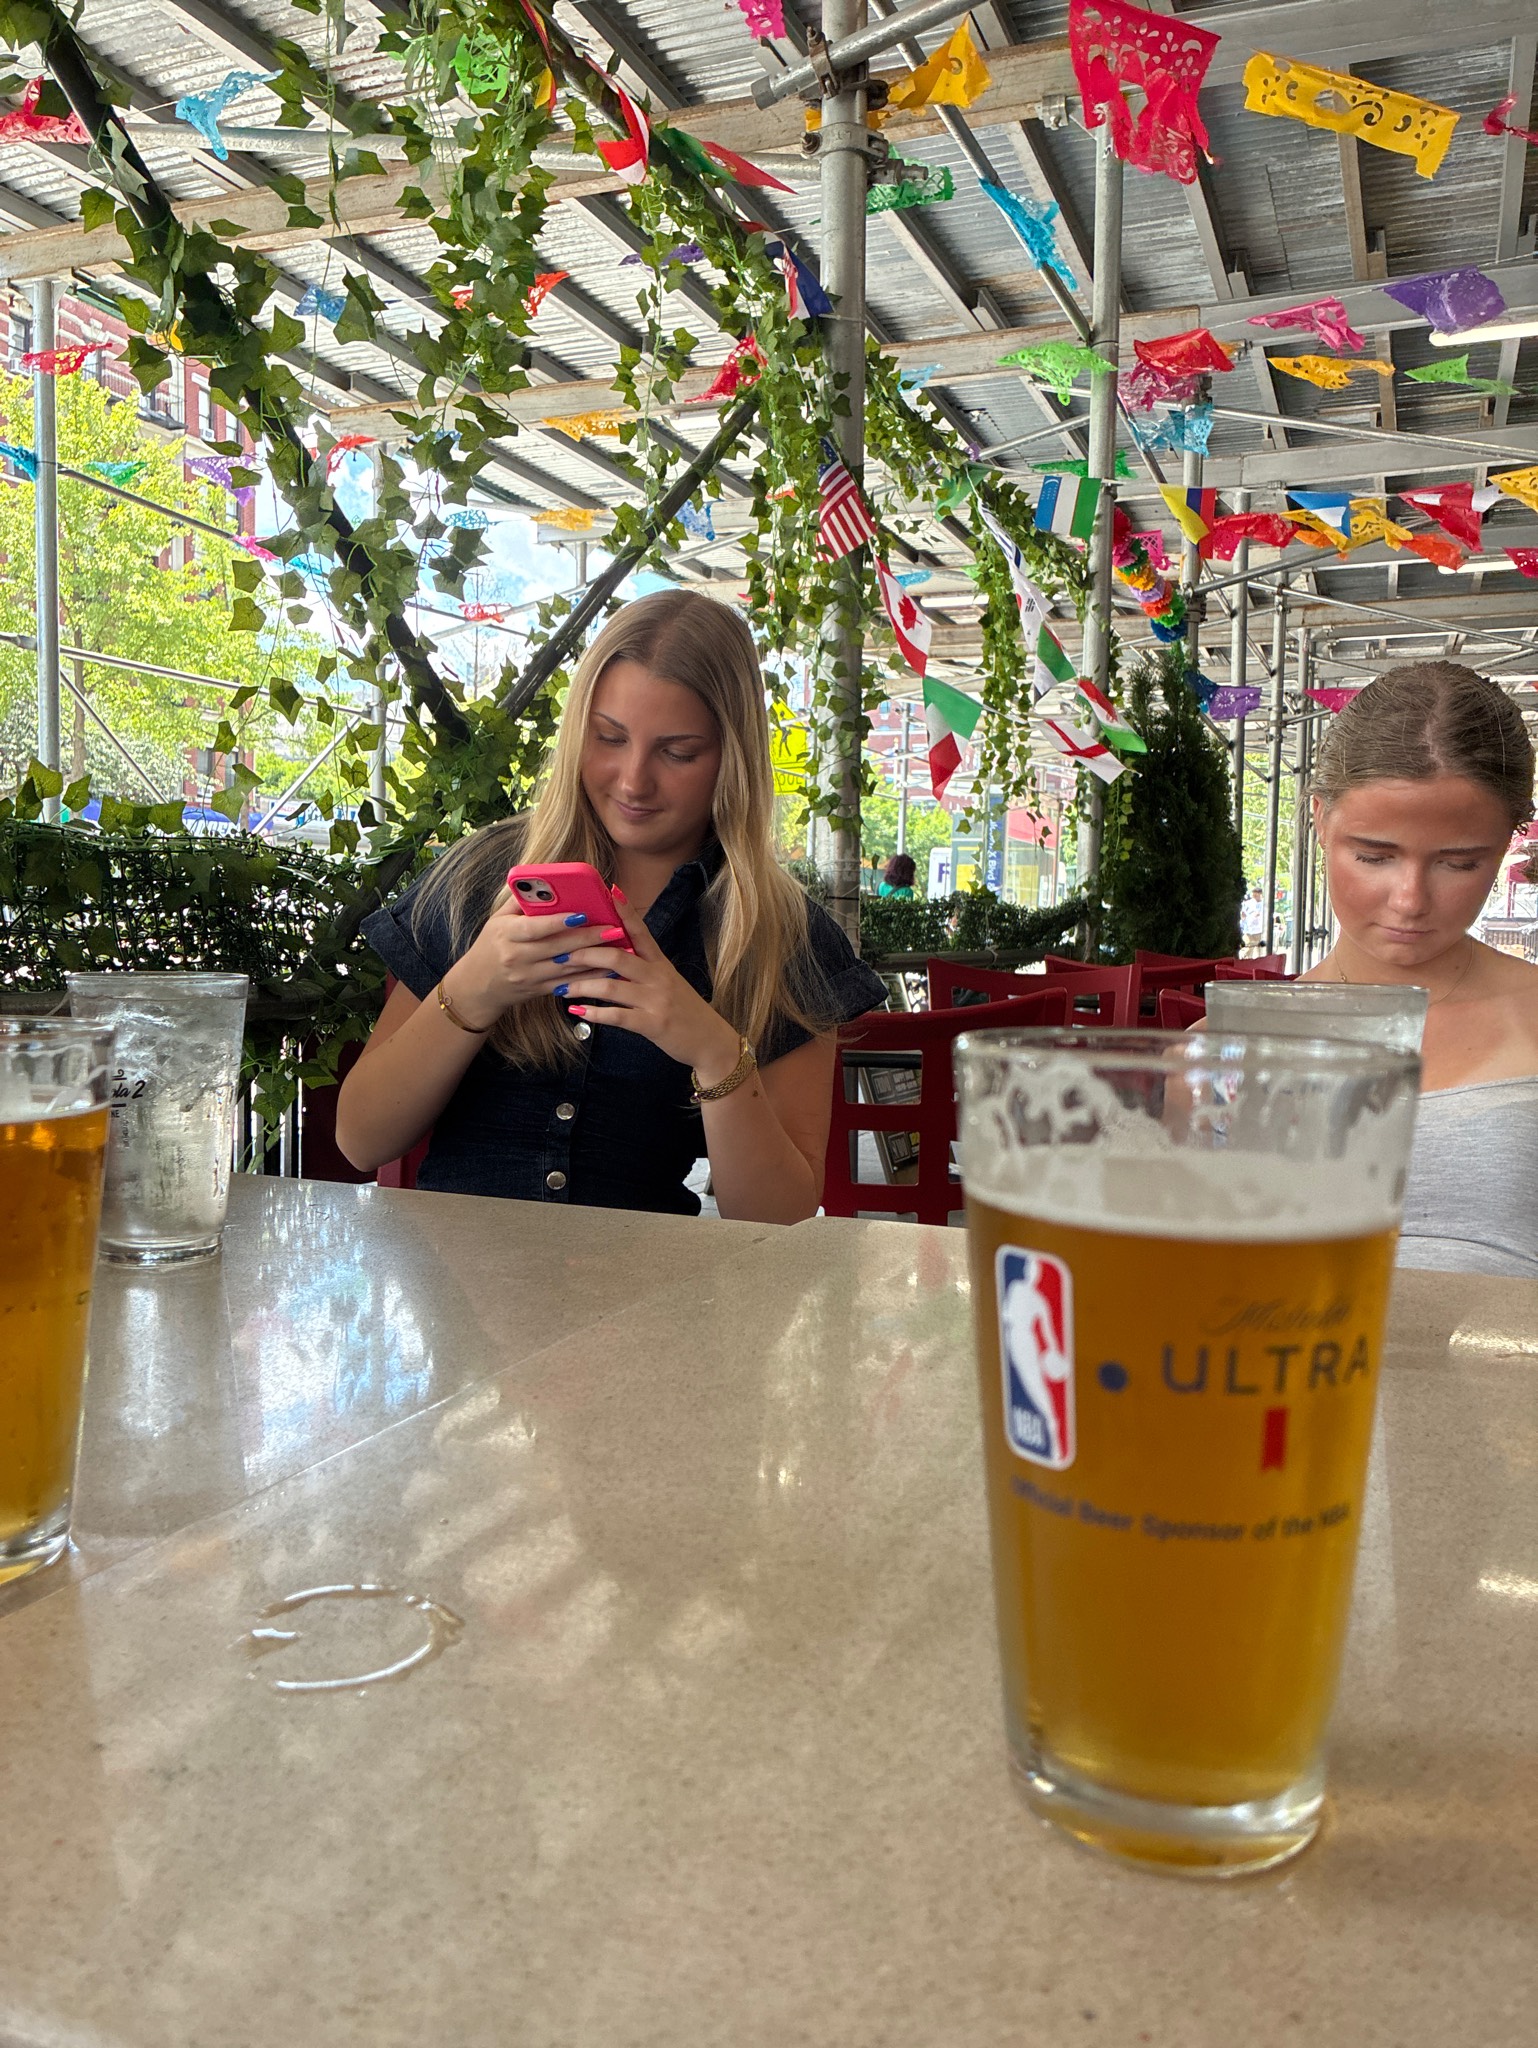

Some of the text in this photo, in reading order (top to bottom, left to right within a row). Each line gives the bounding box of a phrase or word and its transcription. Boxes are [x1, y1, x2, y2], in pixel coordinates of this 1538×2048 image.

[987, 859, 998, 881] Blvd
[131, 1080, 146, 1099] 2
[1161, 1334, 1370, 1396] ULTRA
[1012, 1406, 1044, 1447] NBA
[1253, 1515, 1277, 1541] of
